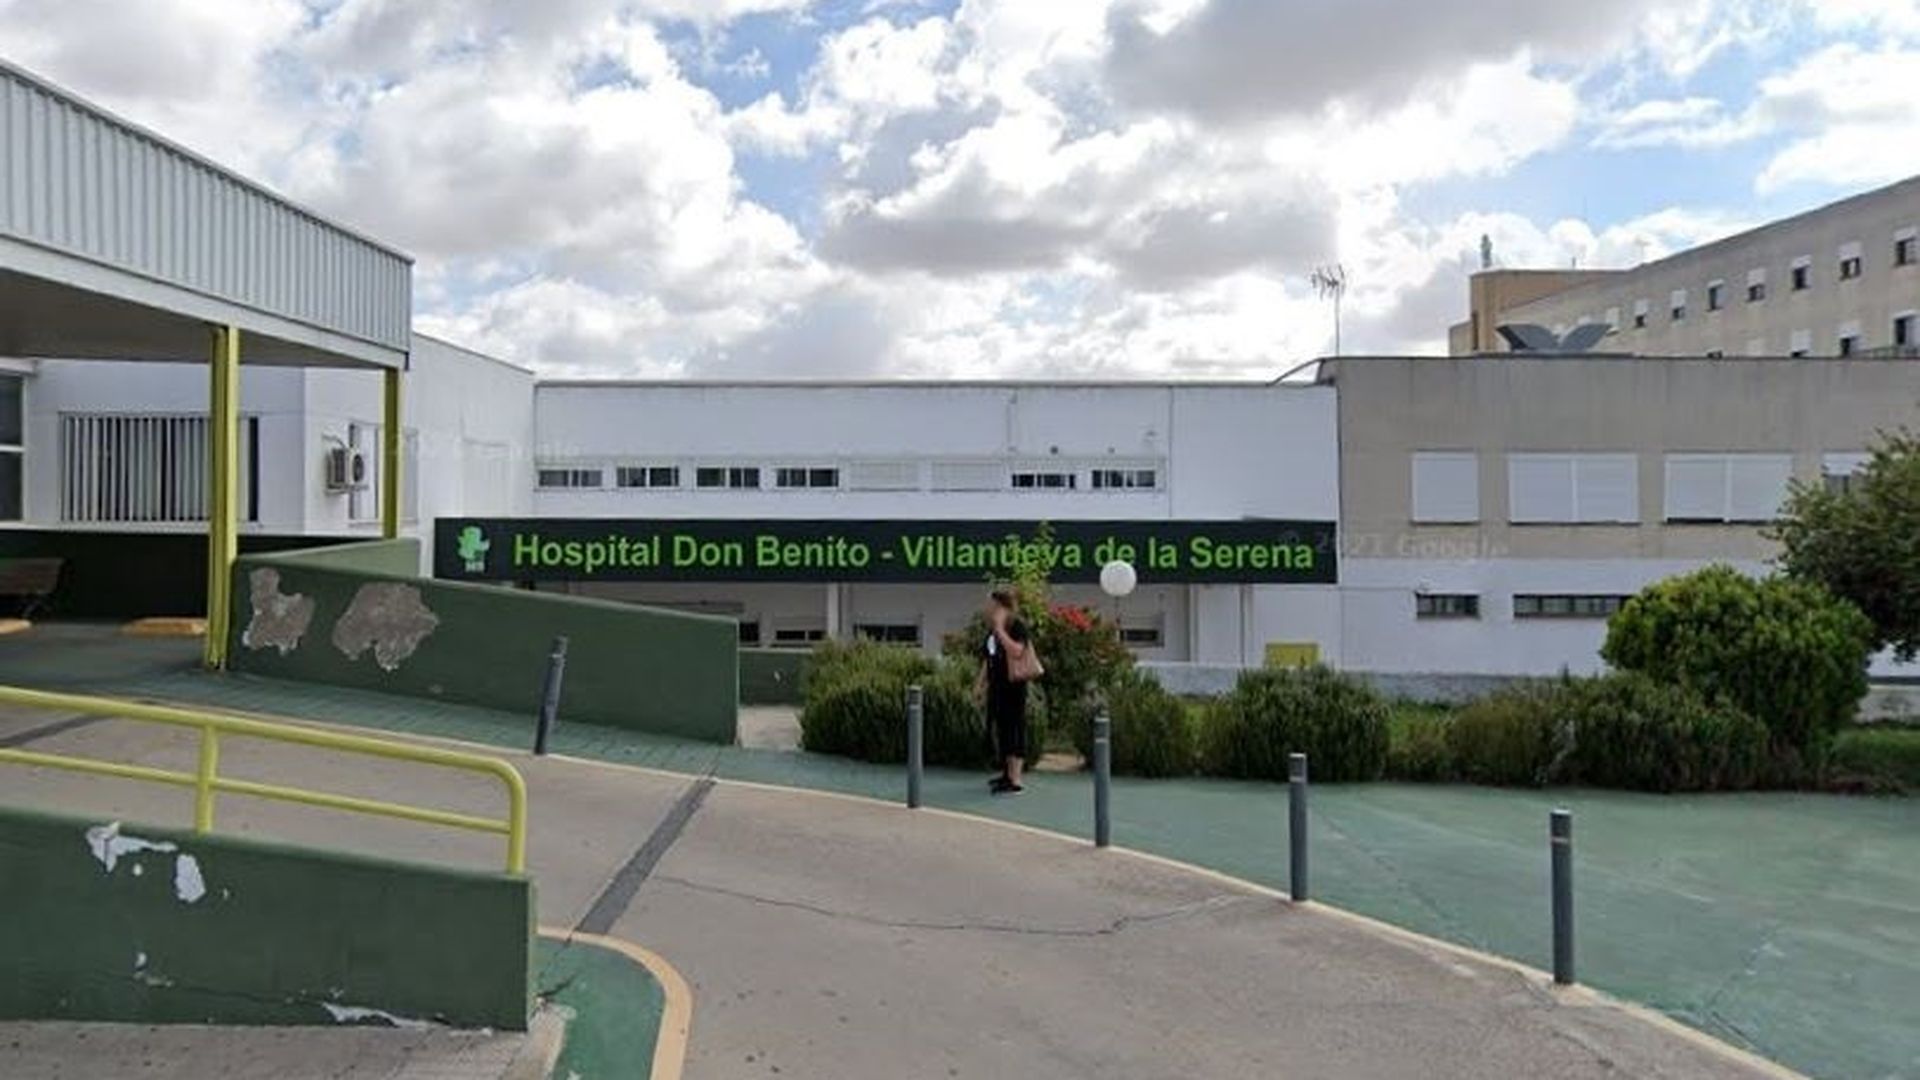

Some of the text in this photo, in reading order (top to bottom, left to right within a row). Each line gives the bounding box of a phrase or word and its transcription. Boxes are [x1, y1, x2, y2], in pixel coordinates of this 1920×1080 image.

[514, 535, 660, 575] Hospital
[672, 535, 743, 566] Don
[755, 535, 870, 567] Benito
[900, 535, 1081, 568] Villanueva
[1093, 536, 1136, 568] de
[1148, 538, 1178, 568] la
[1190, 536, 1314, 569] Serena
